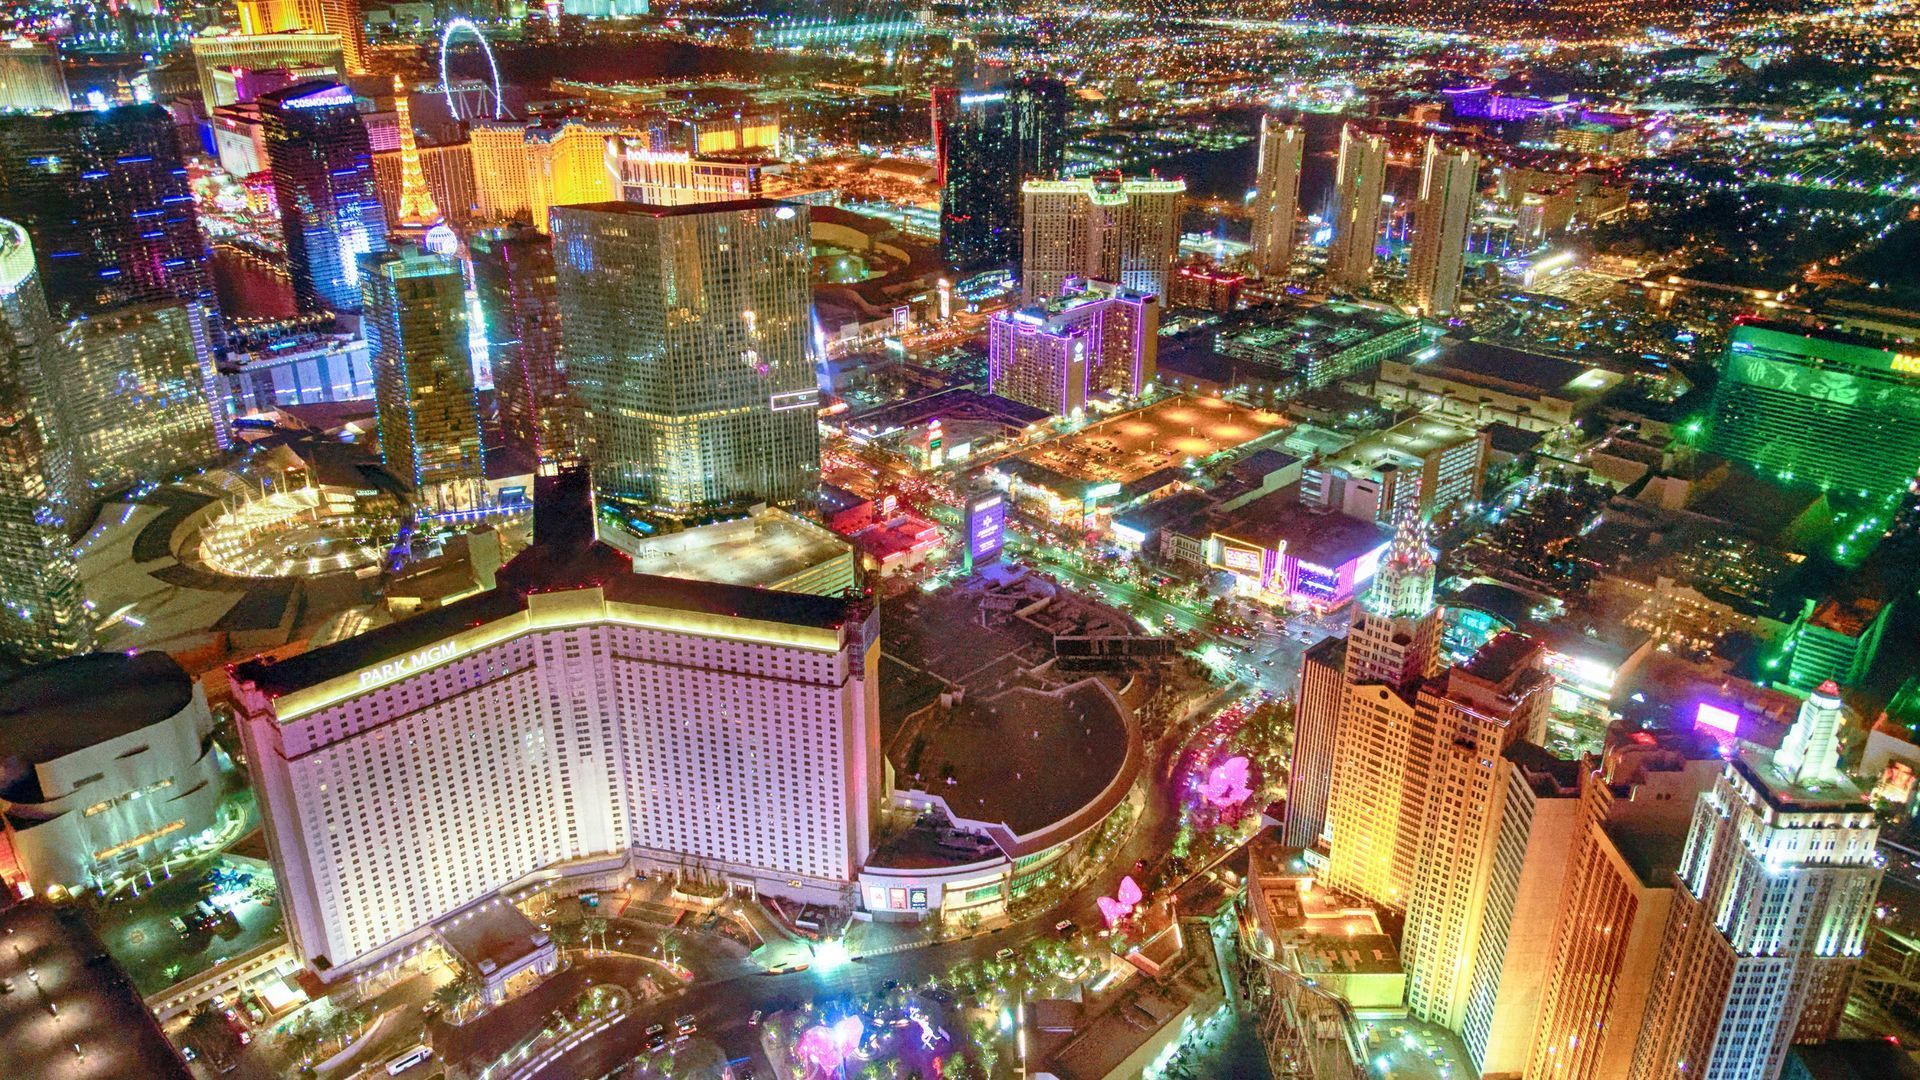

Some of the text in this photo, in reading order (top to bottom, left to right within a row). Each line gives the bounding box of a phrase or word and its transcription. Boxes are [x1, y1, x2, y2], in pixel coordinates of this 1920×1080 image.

[294, 95, 353, 108] COSMOPOLITAN
[626, 147, 689, 164] hollywood
[1227, 550, 1257, 560] ROSS
[359, 641, 457, 686] PARK MGM
